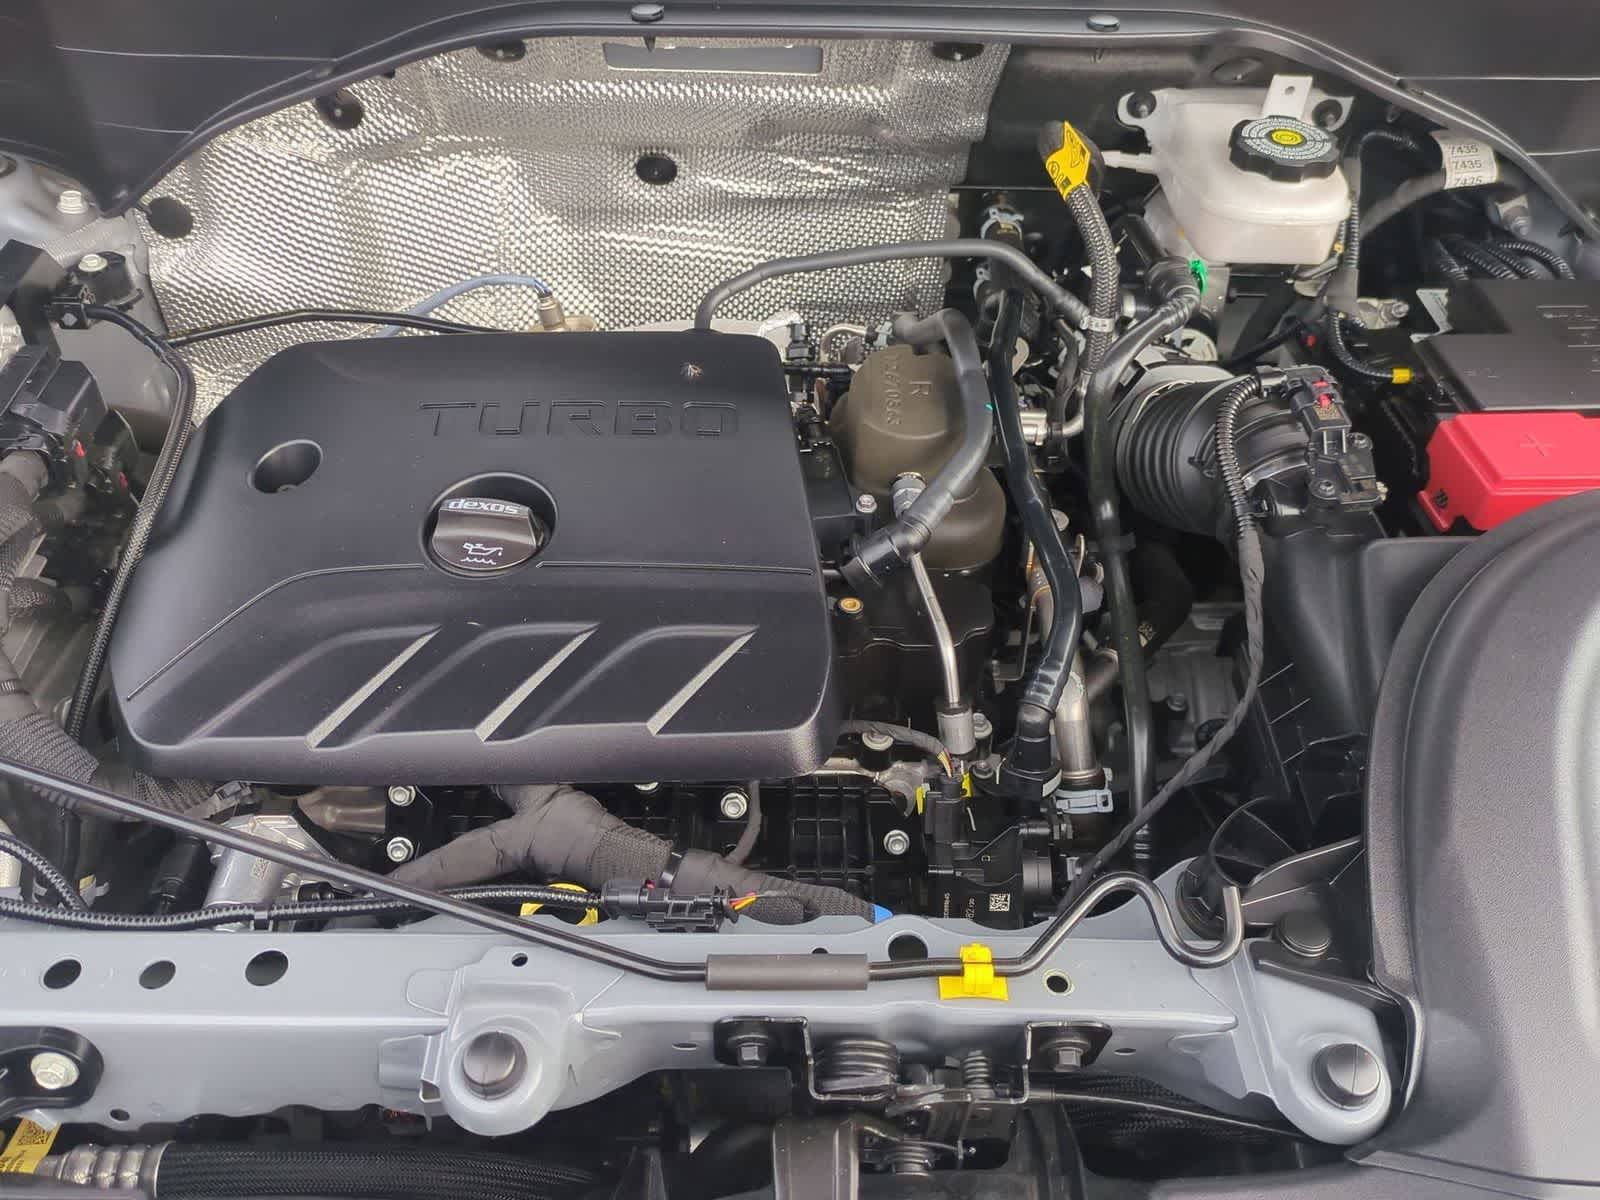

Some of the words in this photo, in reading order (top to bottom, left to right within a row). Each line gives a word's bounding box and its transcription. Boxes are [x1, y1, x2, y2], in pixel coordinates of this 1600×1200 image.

[1453, 160, 1482, 170] 7435
[909, 380, 932, 399] R
[419, 400, 739, 437] TURBO
[448, 499, 518, 514] dexos
